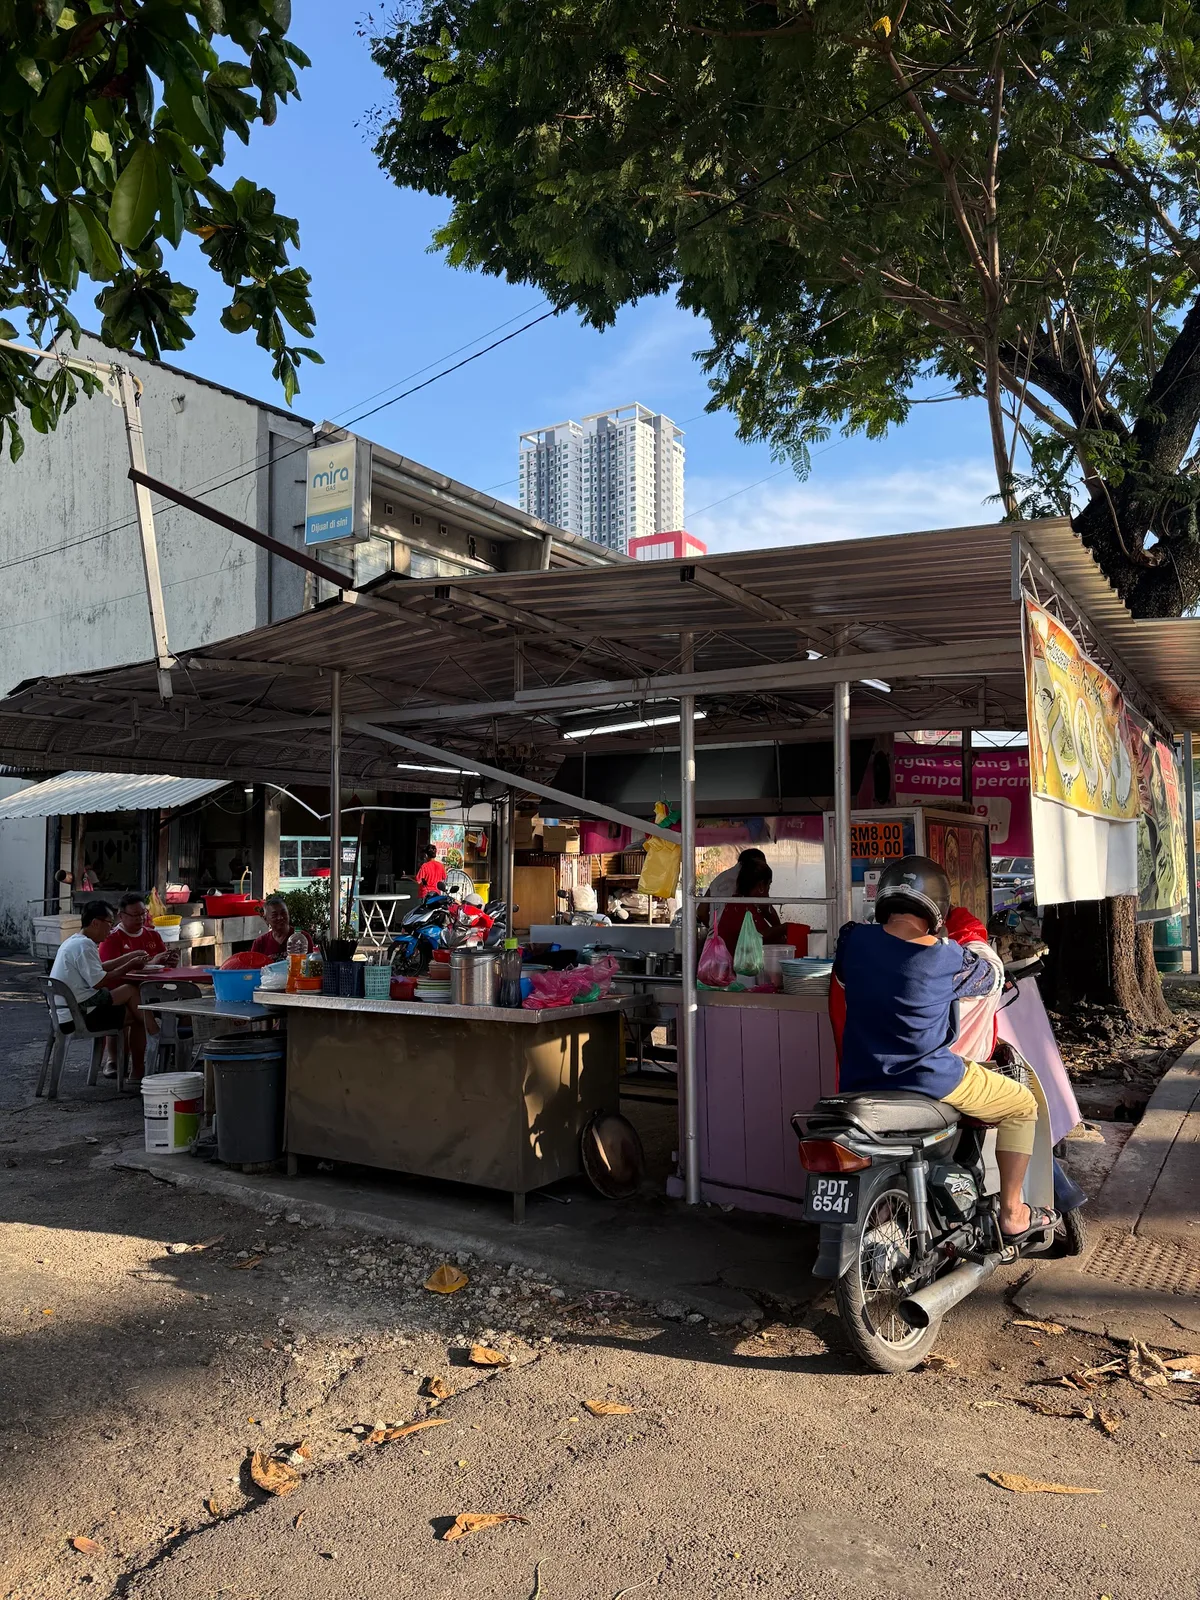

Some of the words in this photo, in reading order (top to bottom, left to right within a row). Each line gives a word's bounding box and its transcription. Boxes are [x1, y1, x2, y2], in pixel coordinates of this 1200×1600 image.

[313, 462, 348, 488] mira
[311, 522, 328, 534] Dijual
[330, 519, 336, 528] di
[337, 517, 348, 527] sini
[943, 759, 1011, 771] seang
[911, 774, 961, 788] empa
[850, 825, 901, 842] RM8.00
[851, 840, 901, 857] RM9.00
[817, 1180, 848, 1196] PDT
[812, 1196, 850, 1214] 6541
